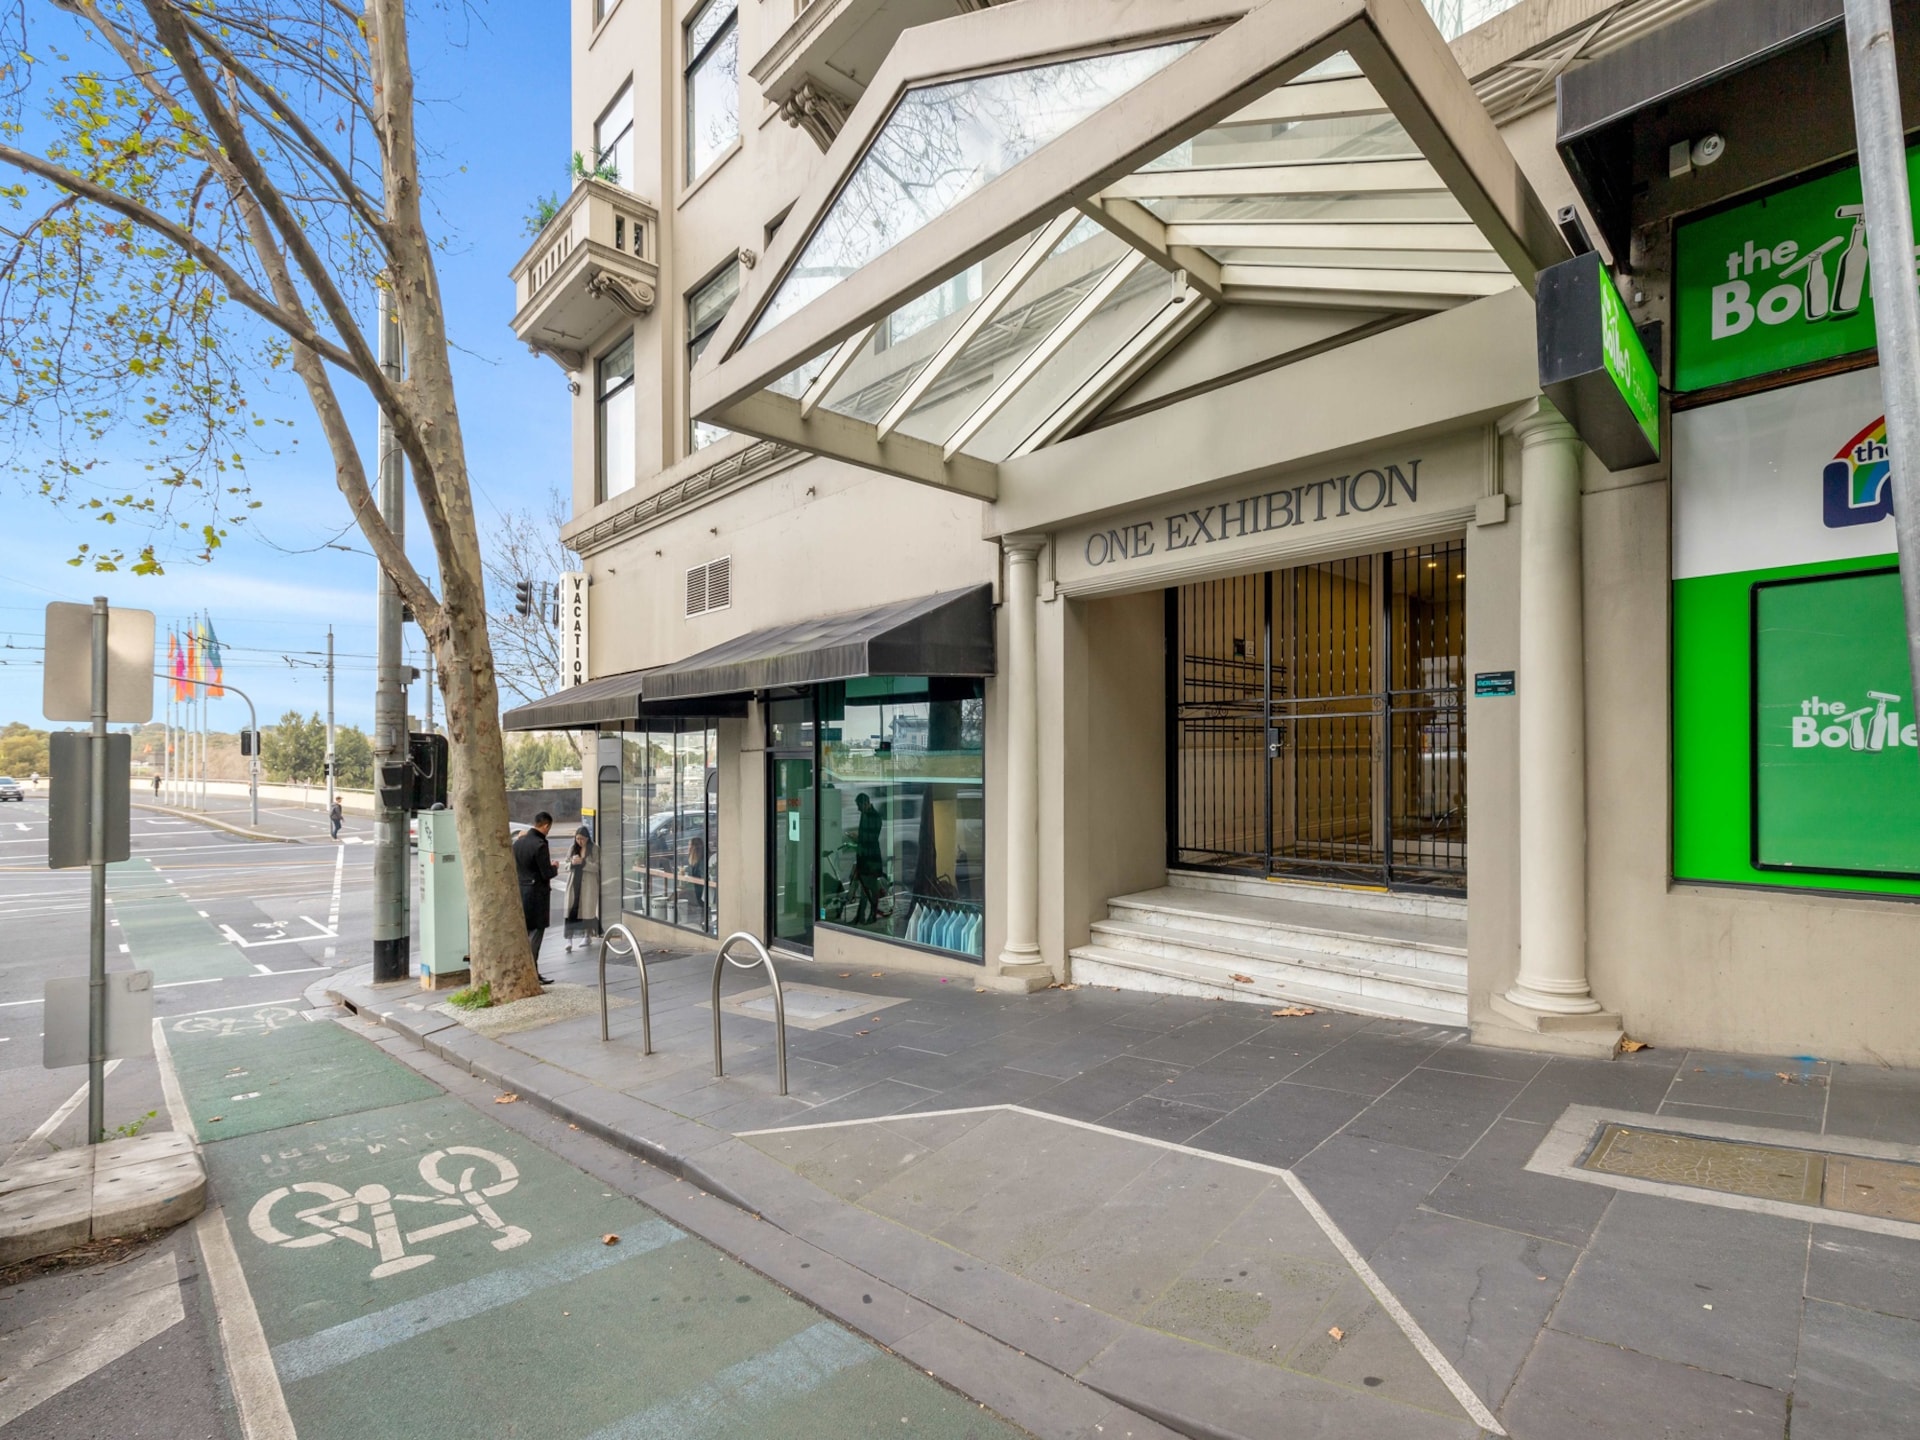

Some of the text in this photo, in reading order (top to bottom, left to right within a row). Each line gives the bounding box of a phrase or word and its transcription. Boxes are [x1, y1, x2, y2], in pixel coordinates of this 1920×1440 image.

[1726, 240, 1799, 280] the
[1854, 440, 1889, 462] th
[1084, 459, 1422, 567] ONE EXHIBITION
[573, 577, 583, 687] VACATION
[1801, 696, 1846, 715] the
